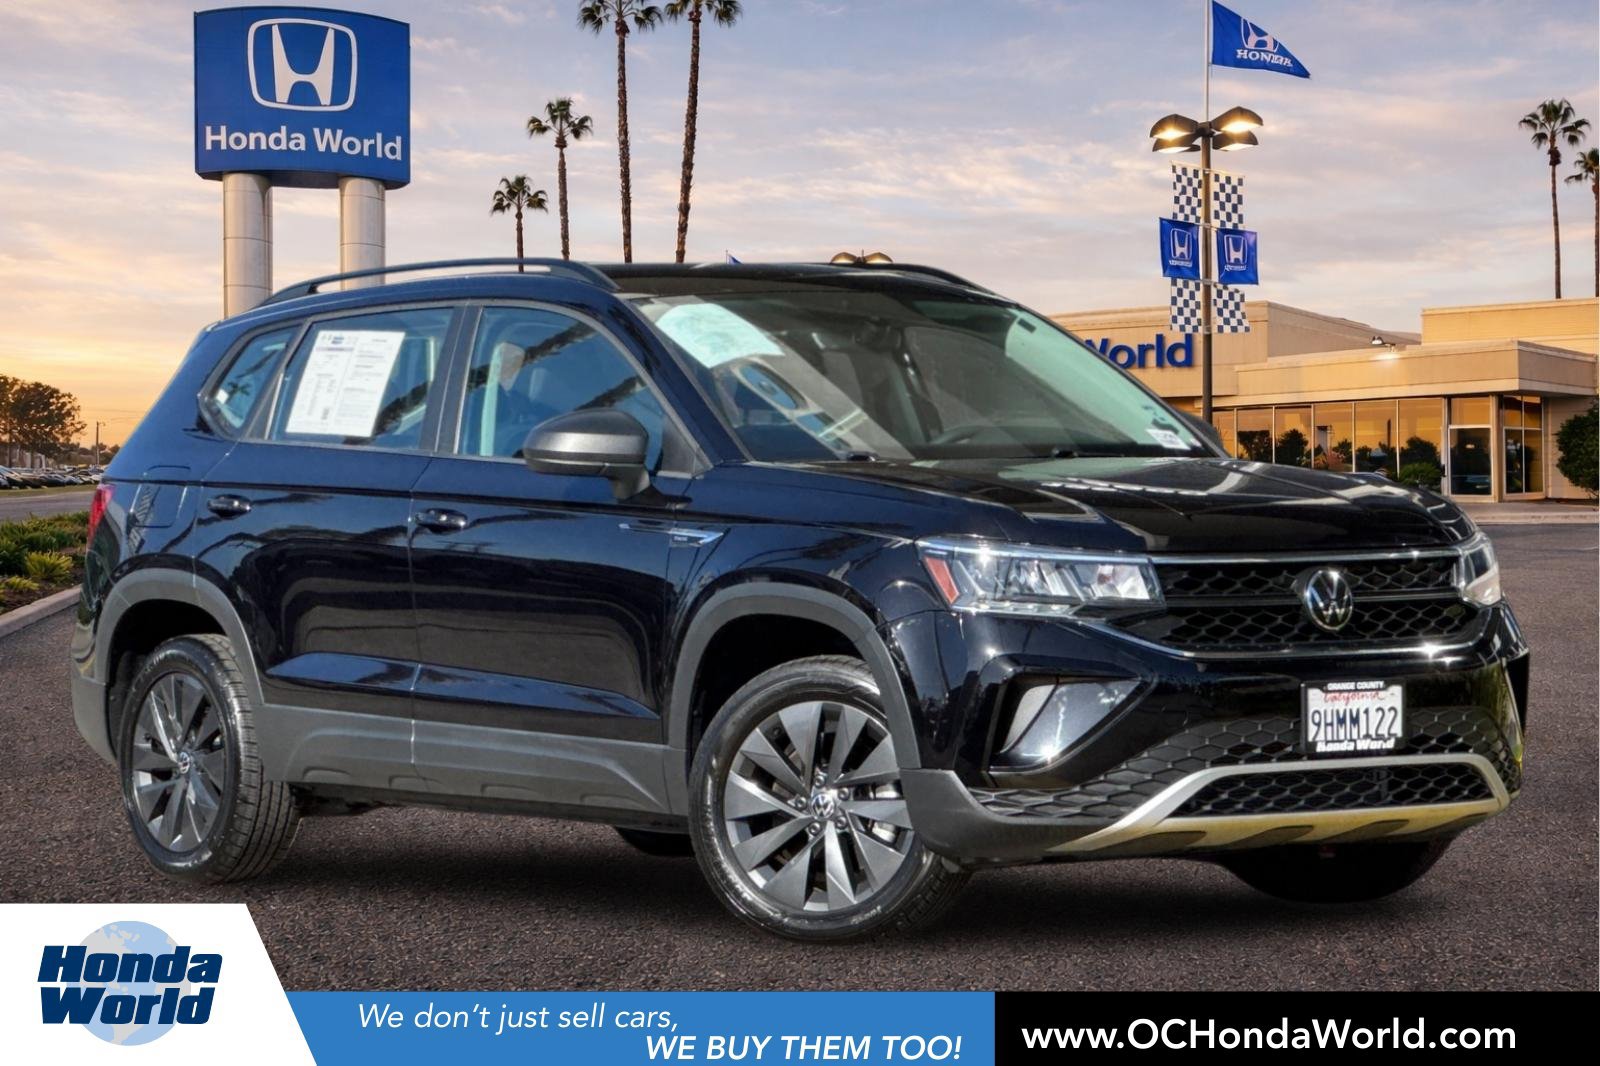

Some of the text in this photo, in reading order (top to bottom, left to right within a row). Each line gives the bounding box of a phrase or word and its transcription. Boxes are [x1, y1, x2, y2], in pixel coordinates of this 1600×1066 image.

[205, 125, 402, 161] Honda World
[1327, 681, 1384, 690] ORANGE COUNTY
[1311, 706, 1398, 741] 9HMM122
[1316, 737, 1396, 753] Honda World
